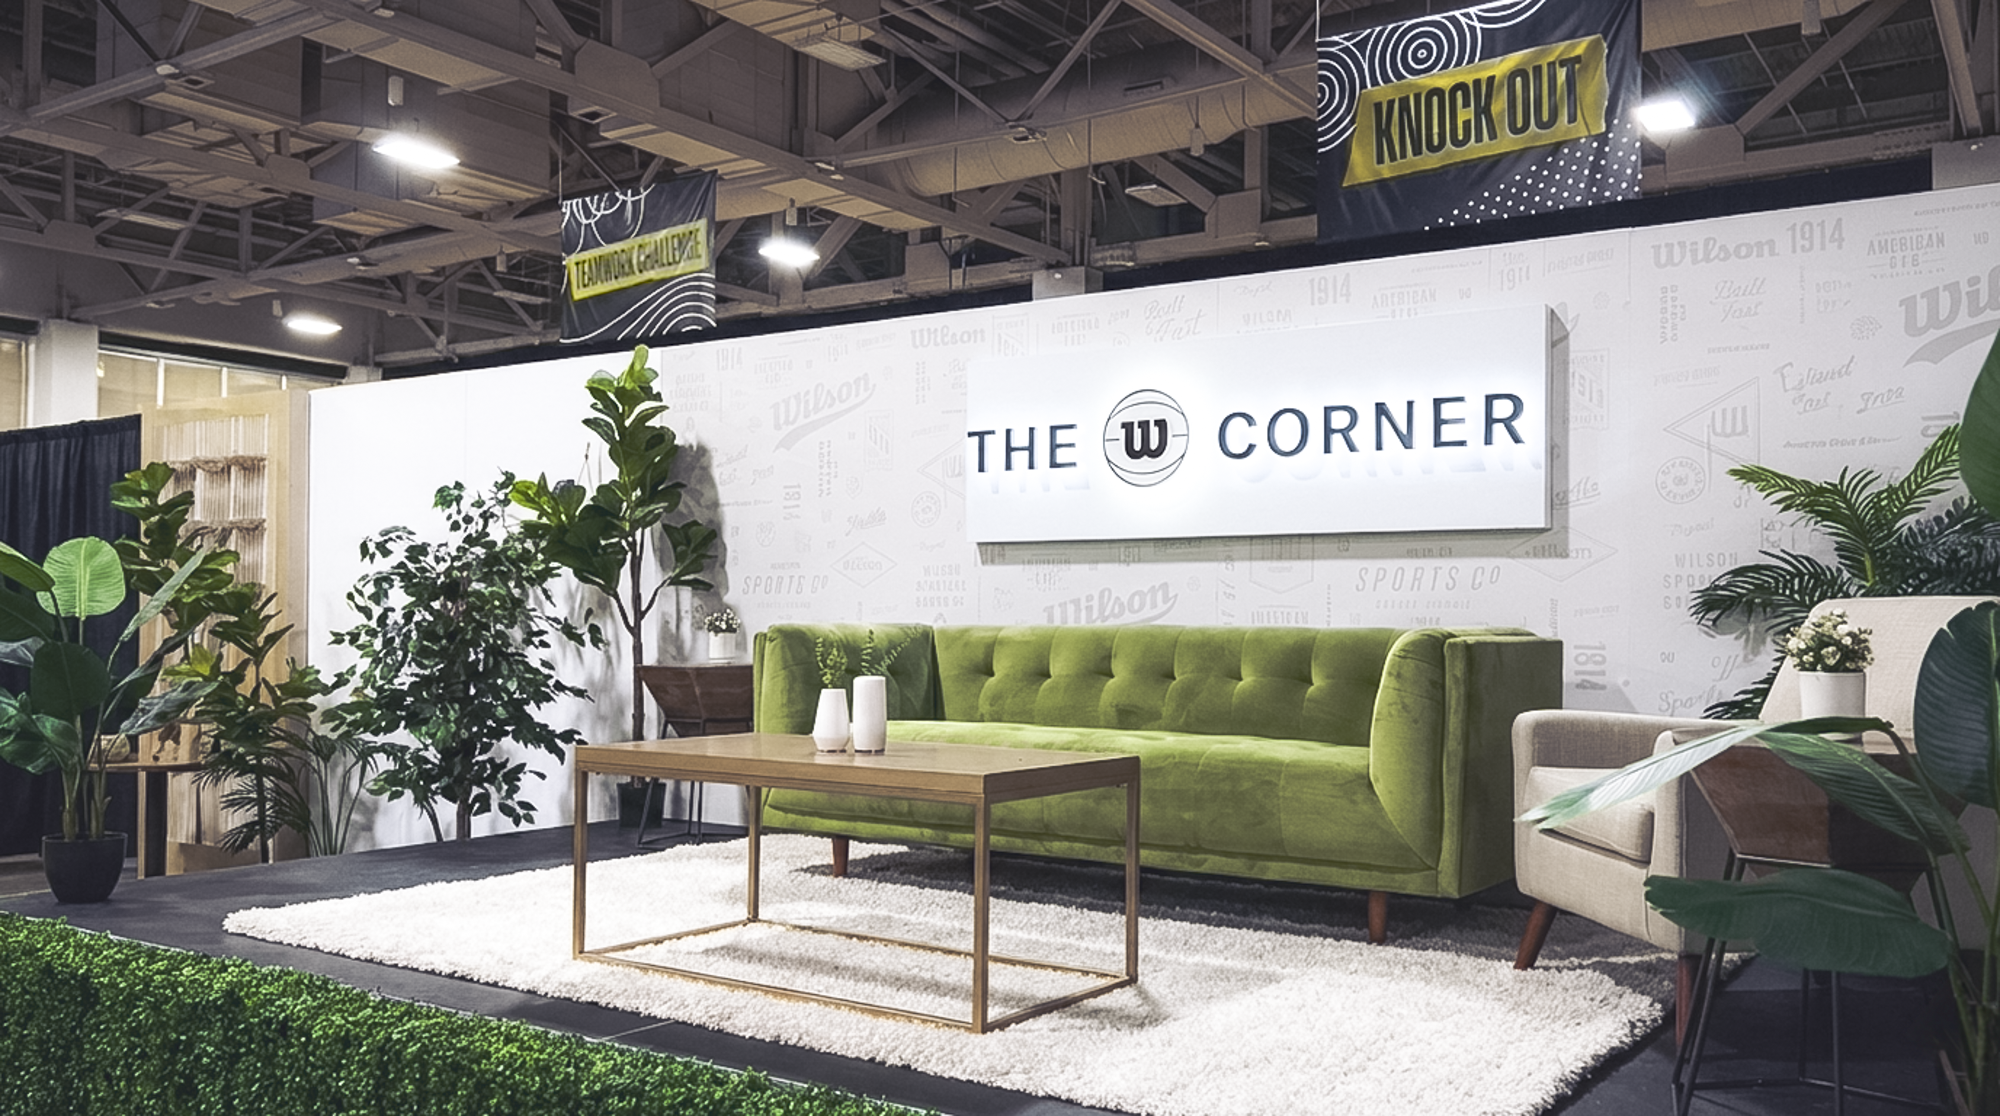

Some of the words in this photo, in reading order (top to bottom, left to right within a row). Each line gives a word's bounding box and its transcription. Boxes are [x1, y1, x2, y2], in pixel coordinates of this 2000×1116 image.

[1373, 75, 1497, 165] KNOCK
[1507, 56, 1582, 136] OUT
[1651, 236, 1780, 269] Wilson
[1786, 217, 1845, 254] 1914
[575, 247, 634, 289] TEAMWORK
[1309, 273, 1352, 306] 1914
[910, 324, 987, 349] Wilson
[769, 372, 871, 431] Wilson
[967, 424, 1077, 473] THE
[1120, 418, 1168, 460] W
[1218, 393, 1525, 460] CORNER
[1355, 566, 1460, 592] SPORTS
[1674, 552, 1738, 568] WILSON
[1042, 581, 1170, 625] Wilson
